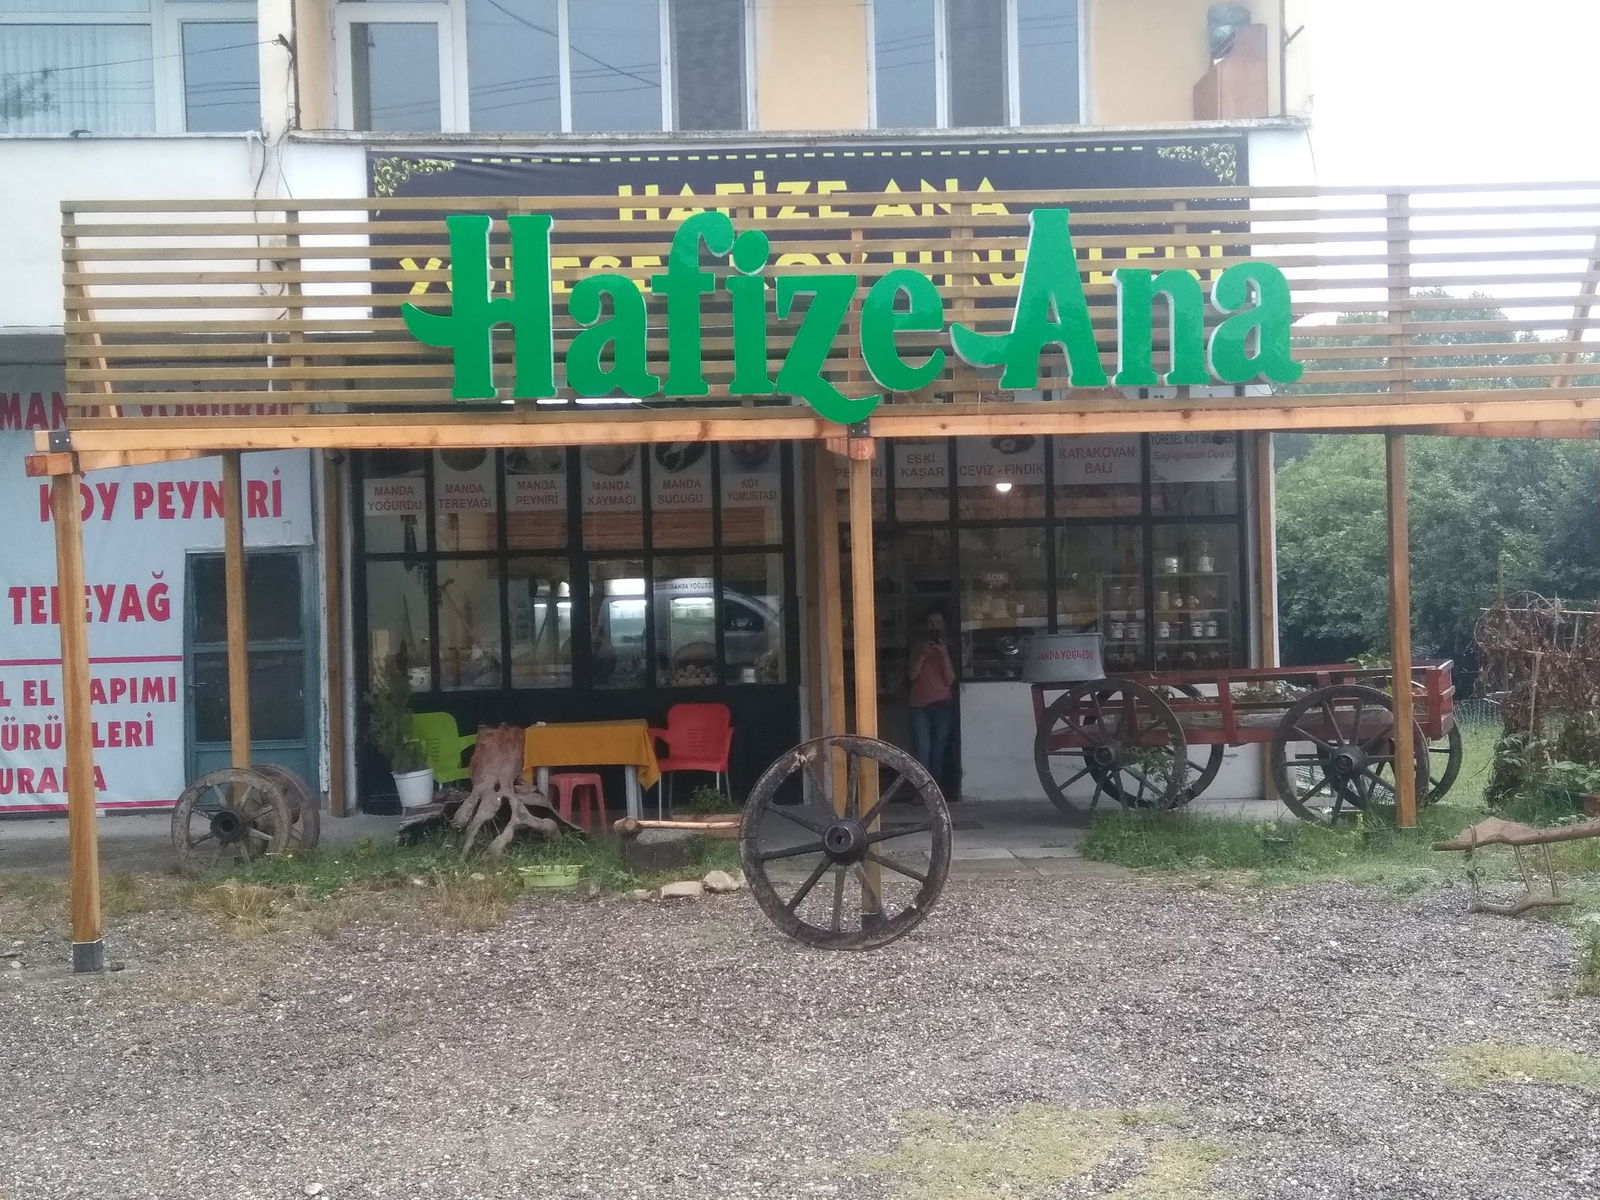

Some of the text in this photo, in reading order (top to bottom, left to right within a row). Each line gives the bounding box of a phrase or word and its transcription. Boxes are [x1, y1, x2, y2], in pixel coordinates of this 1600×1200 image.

[871, 176, 1011, 218] ANA
[401, 208, 1305, 425] Hafize Ana
[1059, 446, 1136, 460] KARAKOVAN
[835, 464, 882, 478] PERİ
[1084, 463, 1113, 474] BALI
[374, 485, 415, 497] MANDA
[444, 483, 486, 495] MANDA
[516, 479, 557, 491] MANDA
[591, 480, 632, 491] MANDA
[662, 478, 702, 490] MANDA
[133, 466, 282, 520] PEYNRİ
[8, 569, 171, 625] TEYAĞ
[23, 679, 55, 706] EL
[90, 676, 176, 705] APIMI
[1, 711, 154, 751] ÜRÜLERİ
[0, 765, 107, 795] URAA
